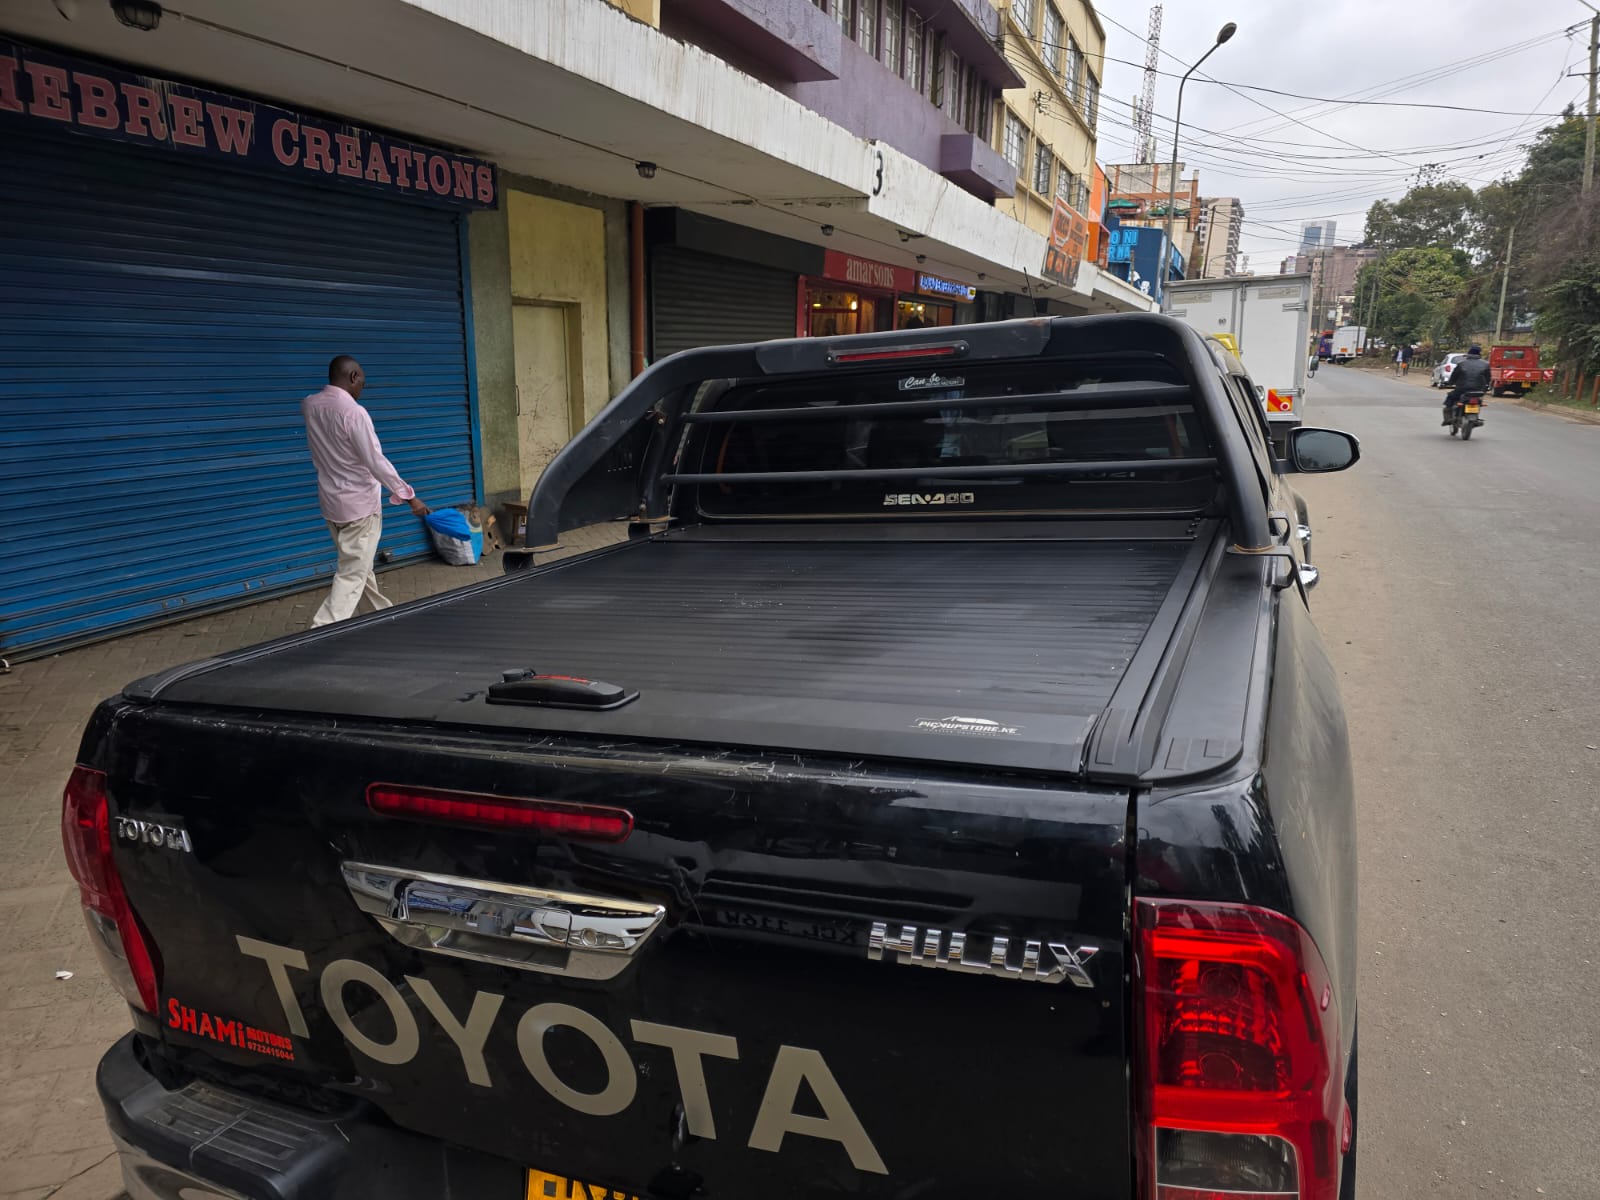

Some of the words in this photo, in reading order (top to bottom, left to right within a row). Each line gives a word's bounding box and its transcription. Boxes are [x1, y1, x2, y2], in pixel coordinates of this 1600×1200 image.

[271, 118, 496, 204] CREATIONS
[872, 149, 884, 197] 3
[845, 257, 896, 289] amarsons
[114, 815, 193, 854] TOYOTA
[866, 921, 1101, 988] HILUX
[234, 933, 890, 1176] TOYOTA
[246, 1026, 293, 1050] MOTORS
